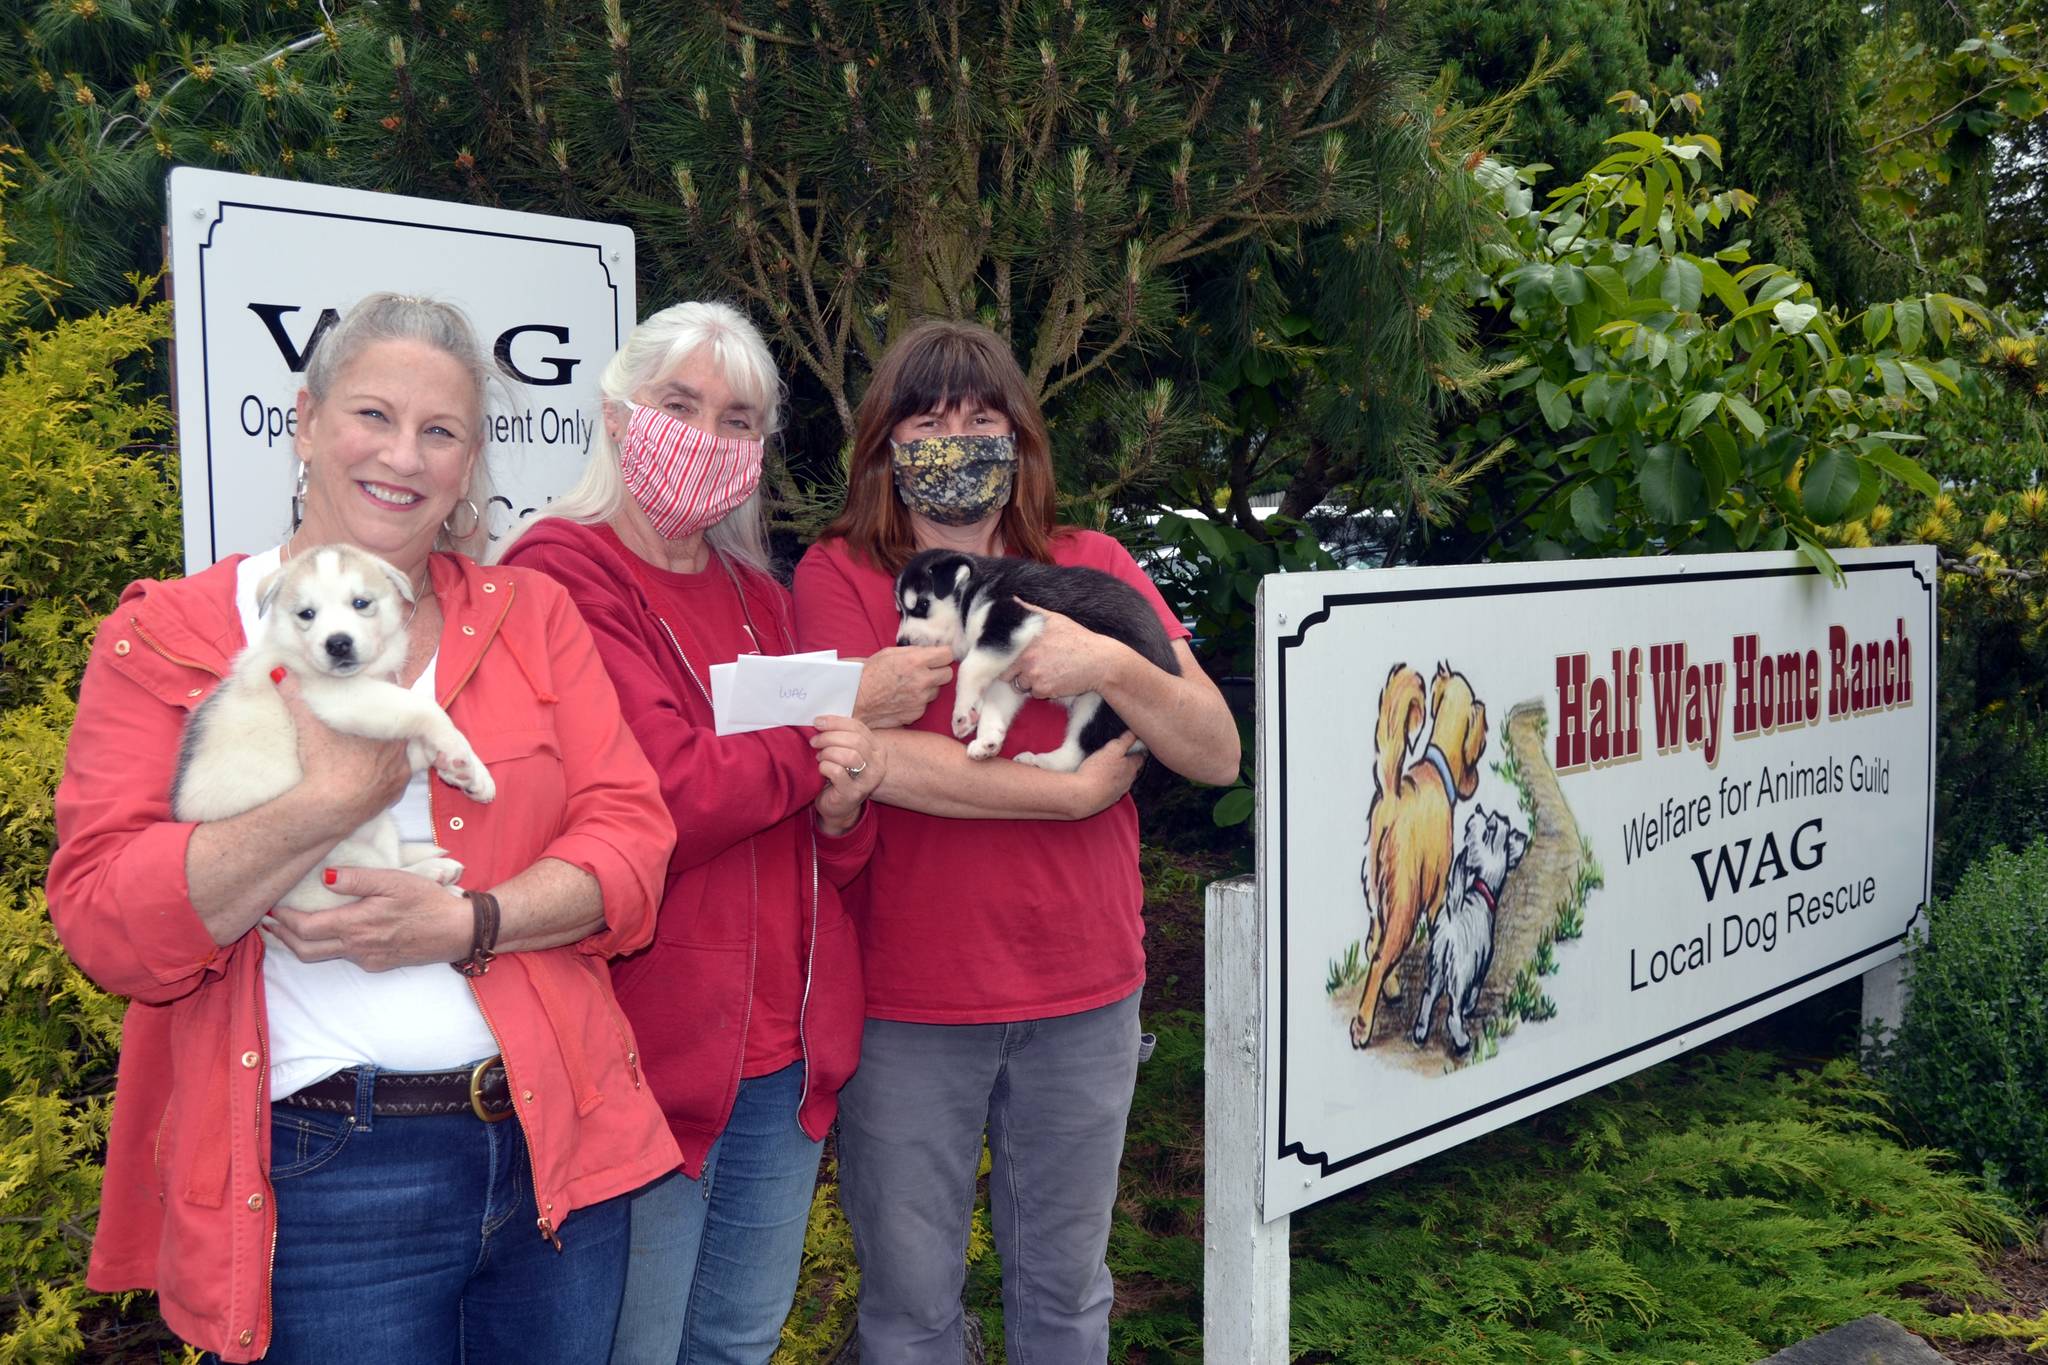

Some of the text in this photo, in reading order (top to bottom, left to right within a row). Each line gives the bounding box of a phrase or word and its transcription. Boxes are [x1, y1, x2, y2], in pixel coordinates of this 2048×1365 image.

[540, 407, 593, 455] Only
[1555, 616, 1912, 775] Half Way Home Ranch
[1623, 754, 1889, 865] Welfare for Animals Guild
[1691, 818, 1827, 902] WAG
[1630, 876, 1876, 991] Local Dog Rescue
